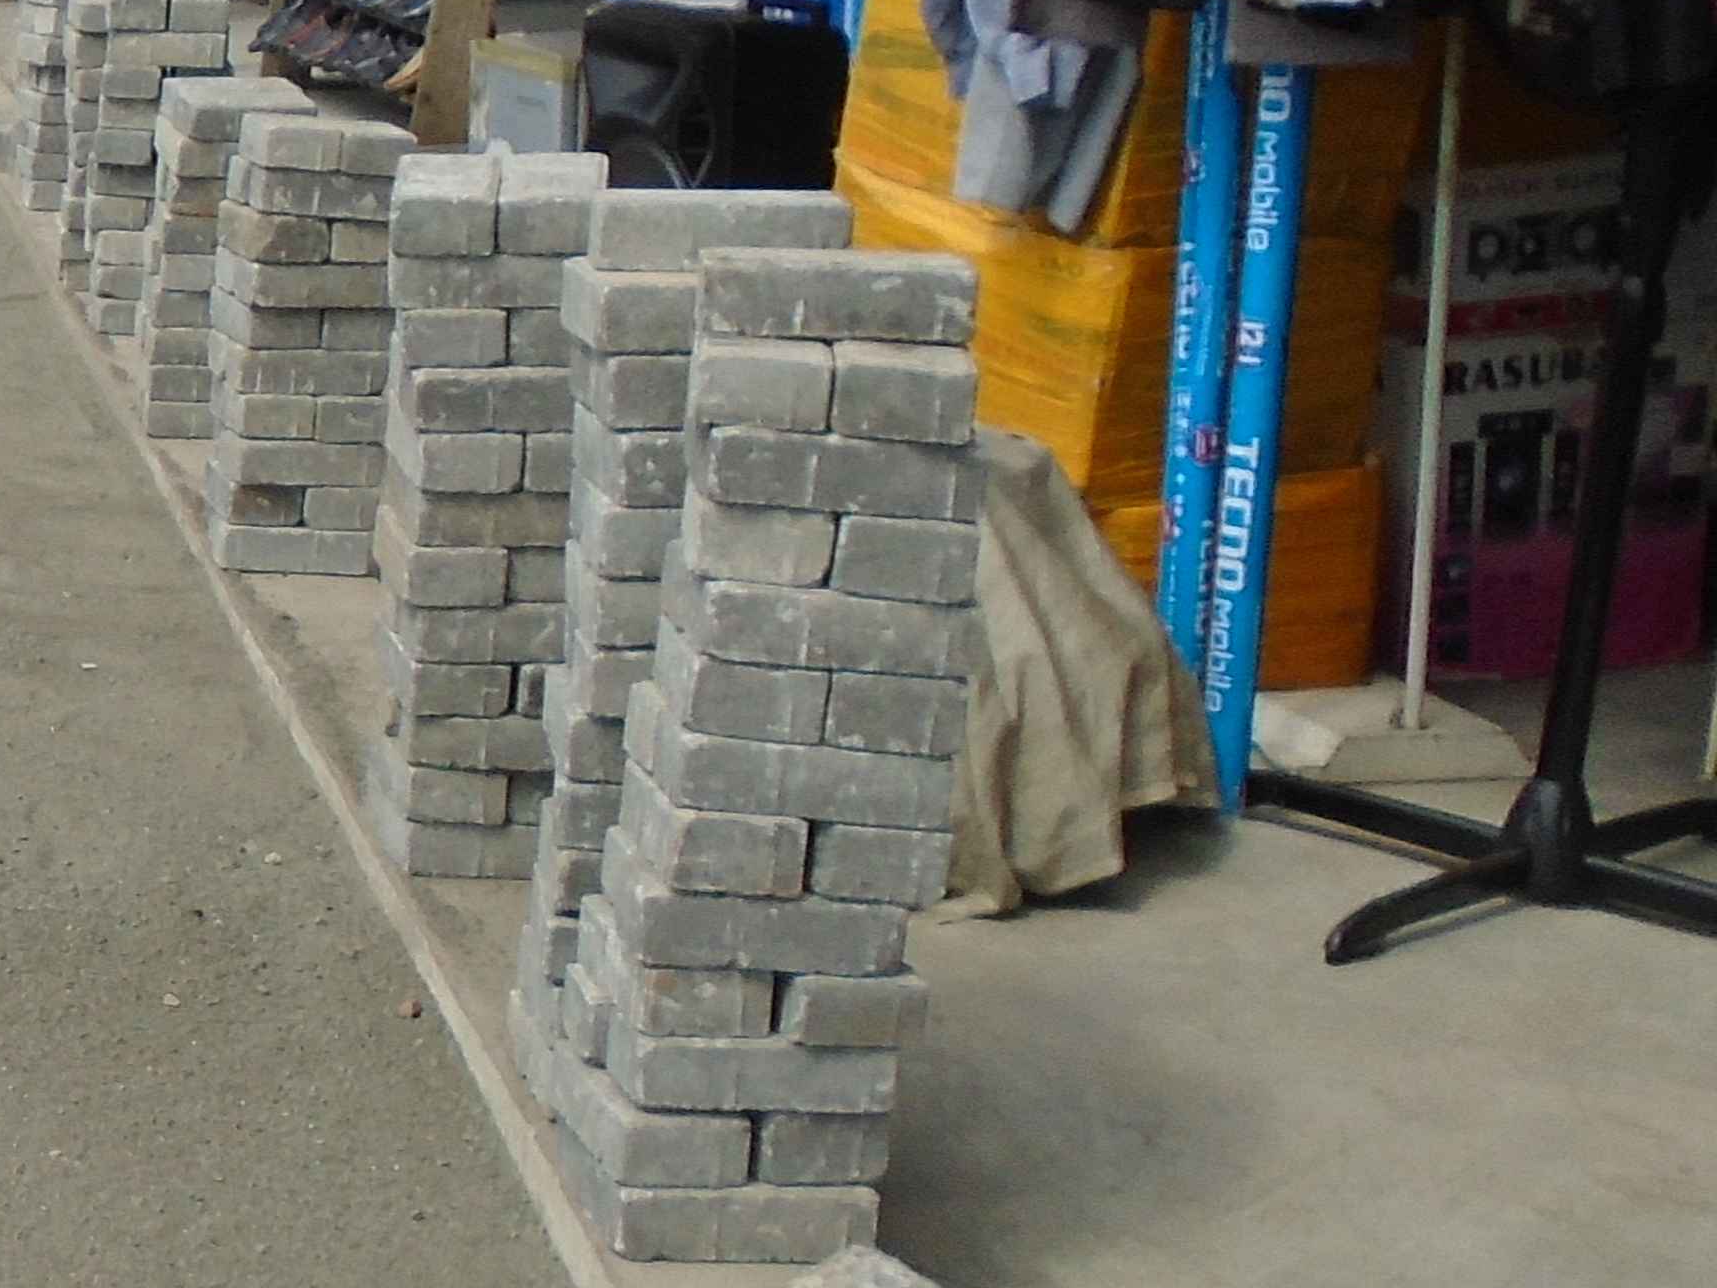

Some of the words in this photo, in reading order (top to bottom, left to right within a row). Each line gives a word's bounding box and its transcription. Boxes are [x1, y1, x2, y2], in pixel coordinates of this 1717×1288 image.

[1245, 129, 1281, 253] mobile
[1216, 435, 1261, 592] TECNO
[1204, 597, 1235, 713] mobile
